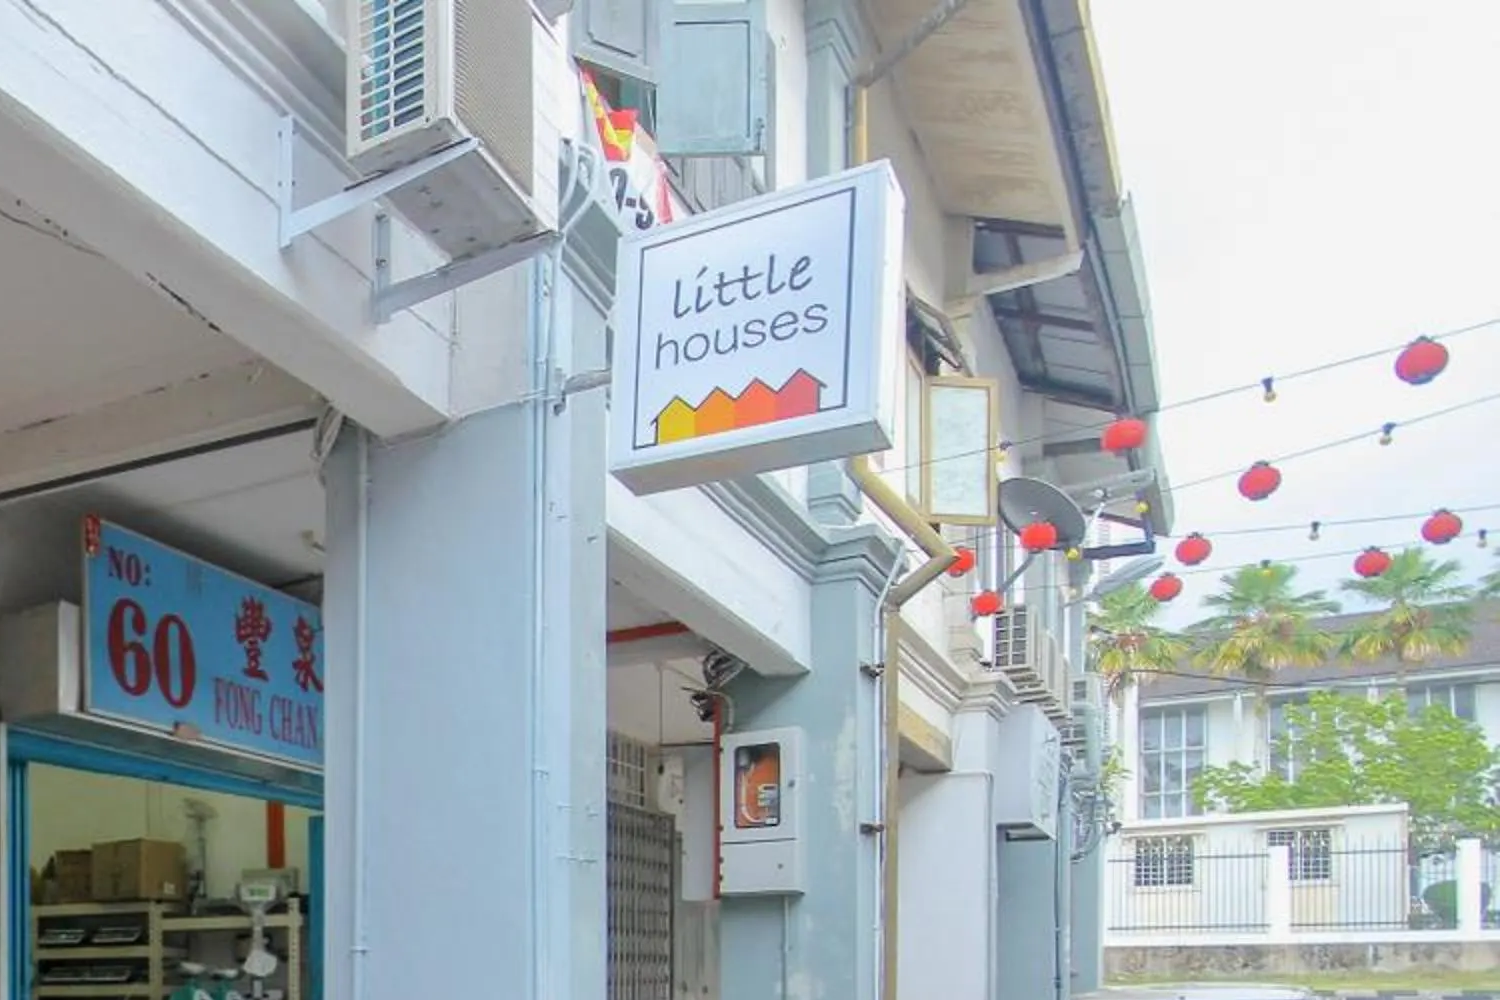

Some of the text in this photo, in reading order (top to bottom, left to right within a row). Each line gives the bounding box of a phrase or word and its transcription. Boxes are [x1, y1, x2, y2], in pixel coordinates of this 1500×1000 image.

[673, 254, 812, 319] little
[655, 303, 828, 369] houses
[107, 547, 152, 587] NO:
[107, 597, 196, 709] 60
[212, 677, 263, 737] FONG
